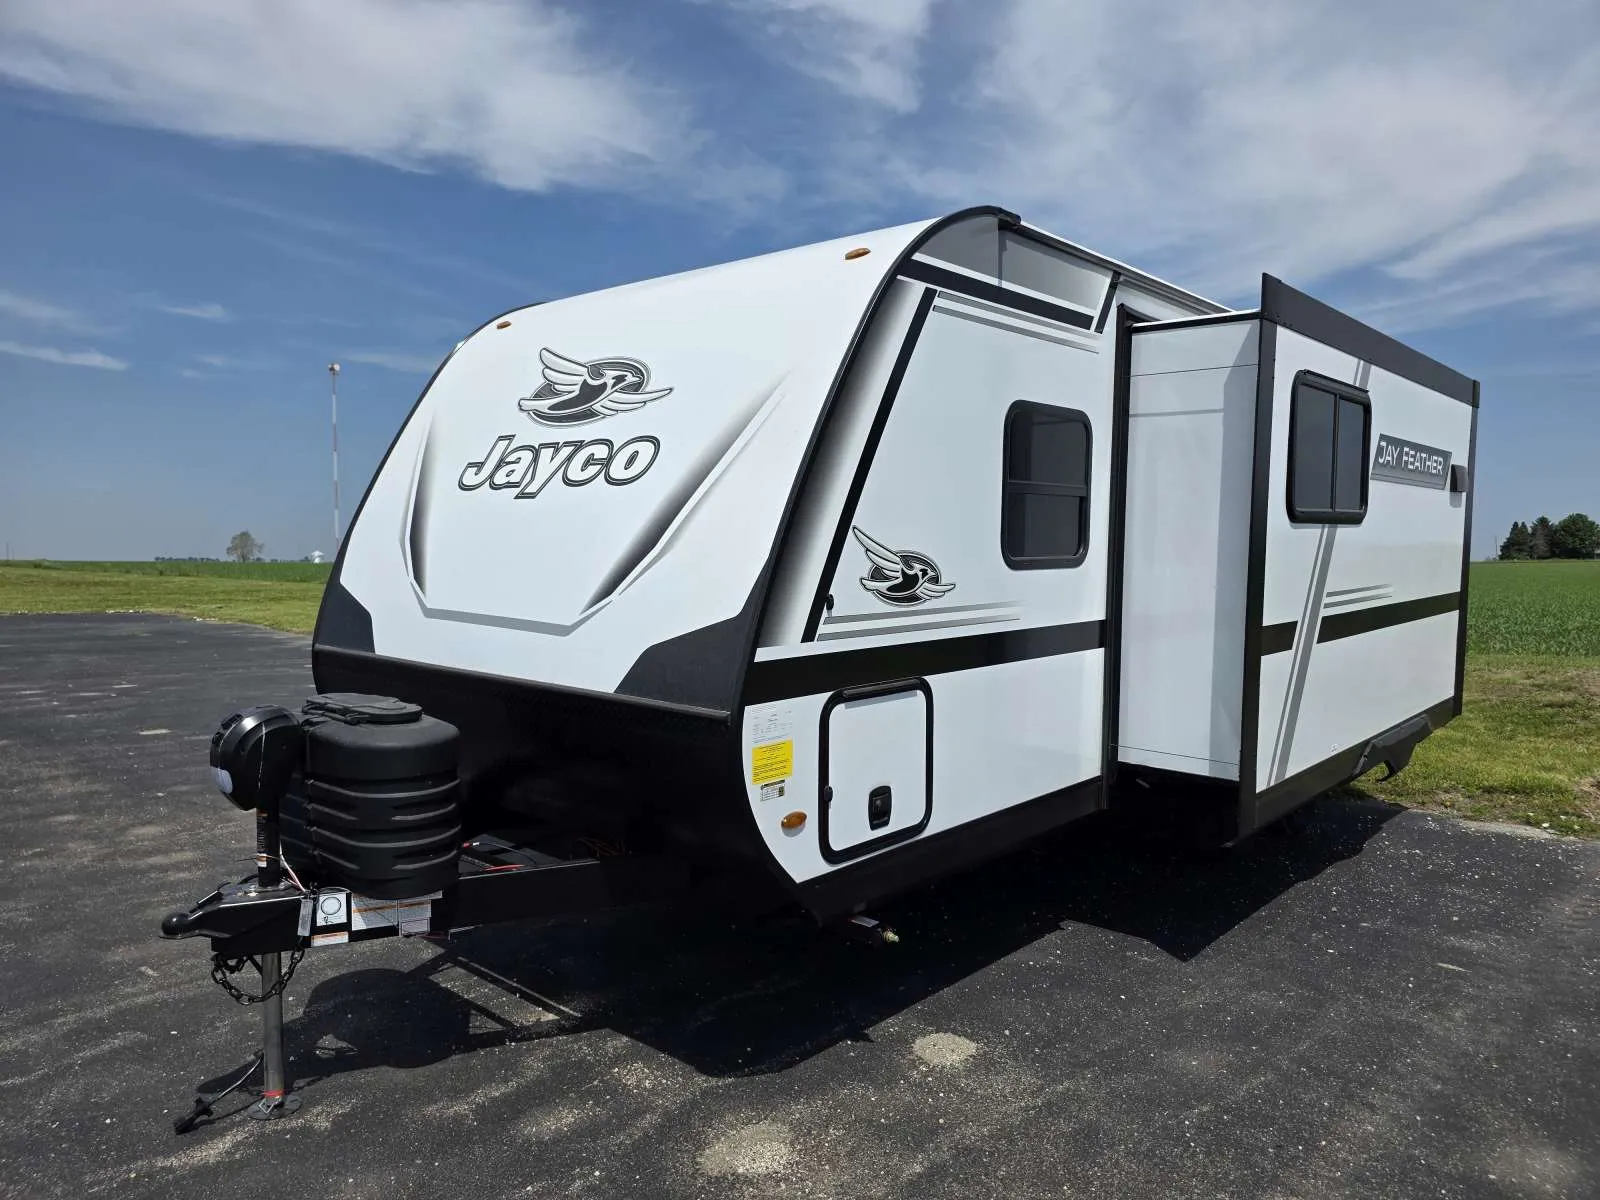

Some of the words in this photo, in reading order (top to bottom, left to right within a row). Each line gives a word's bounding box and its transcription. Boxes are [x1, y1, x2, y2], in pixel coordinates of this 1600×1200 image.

[458, 434, 661, 499] Jayco
[1378, 440, 1400, 466] JAY
[1402, 446, 1444, 475] FEATHER
